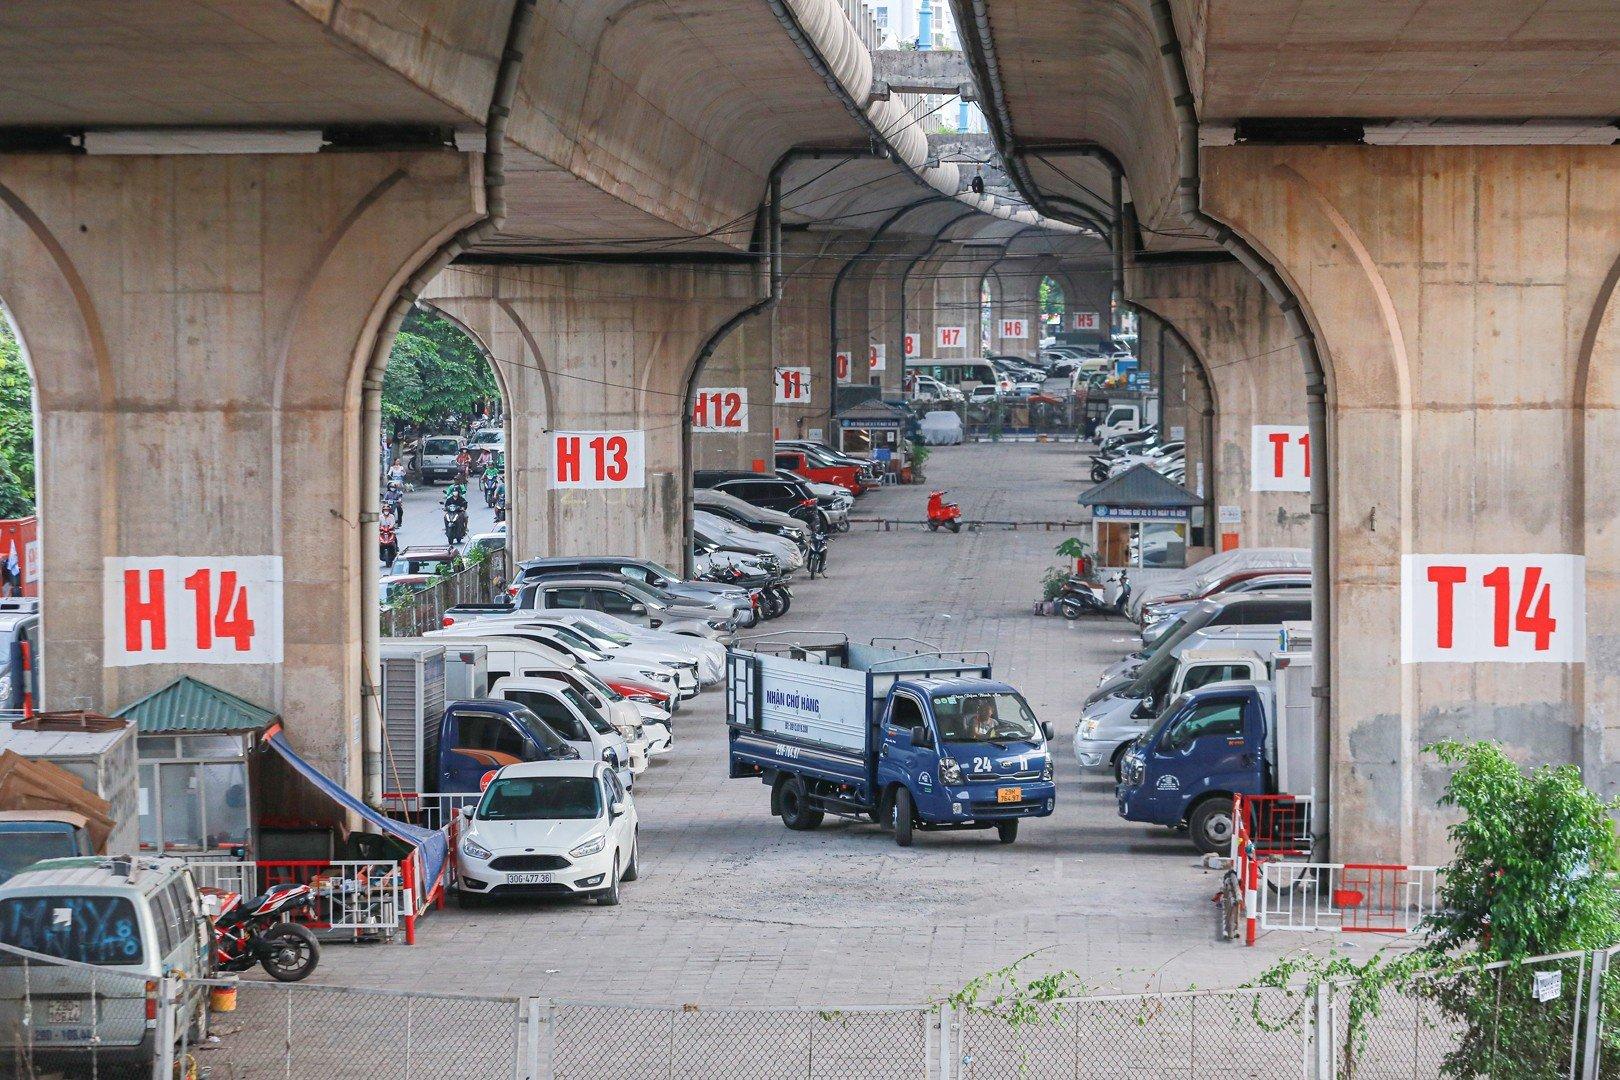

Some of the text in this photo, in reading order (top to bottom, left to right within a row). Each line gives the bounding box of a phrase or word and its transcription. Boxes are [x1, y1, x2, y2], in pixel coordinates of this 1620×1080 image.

[942, 329, 960, 345] H7
[1269, 433, 1289, 477] T
[184, 567, 255, 652] 14
[1482, 565, 1557, 651] 14
[973, 756, 992, 773] 24
